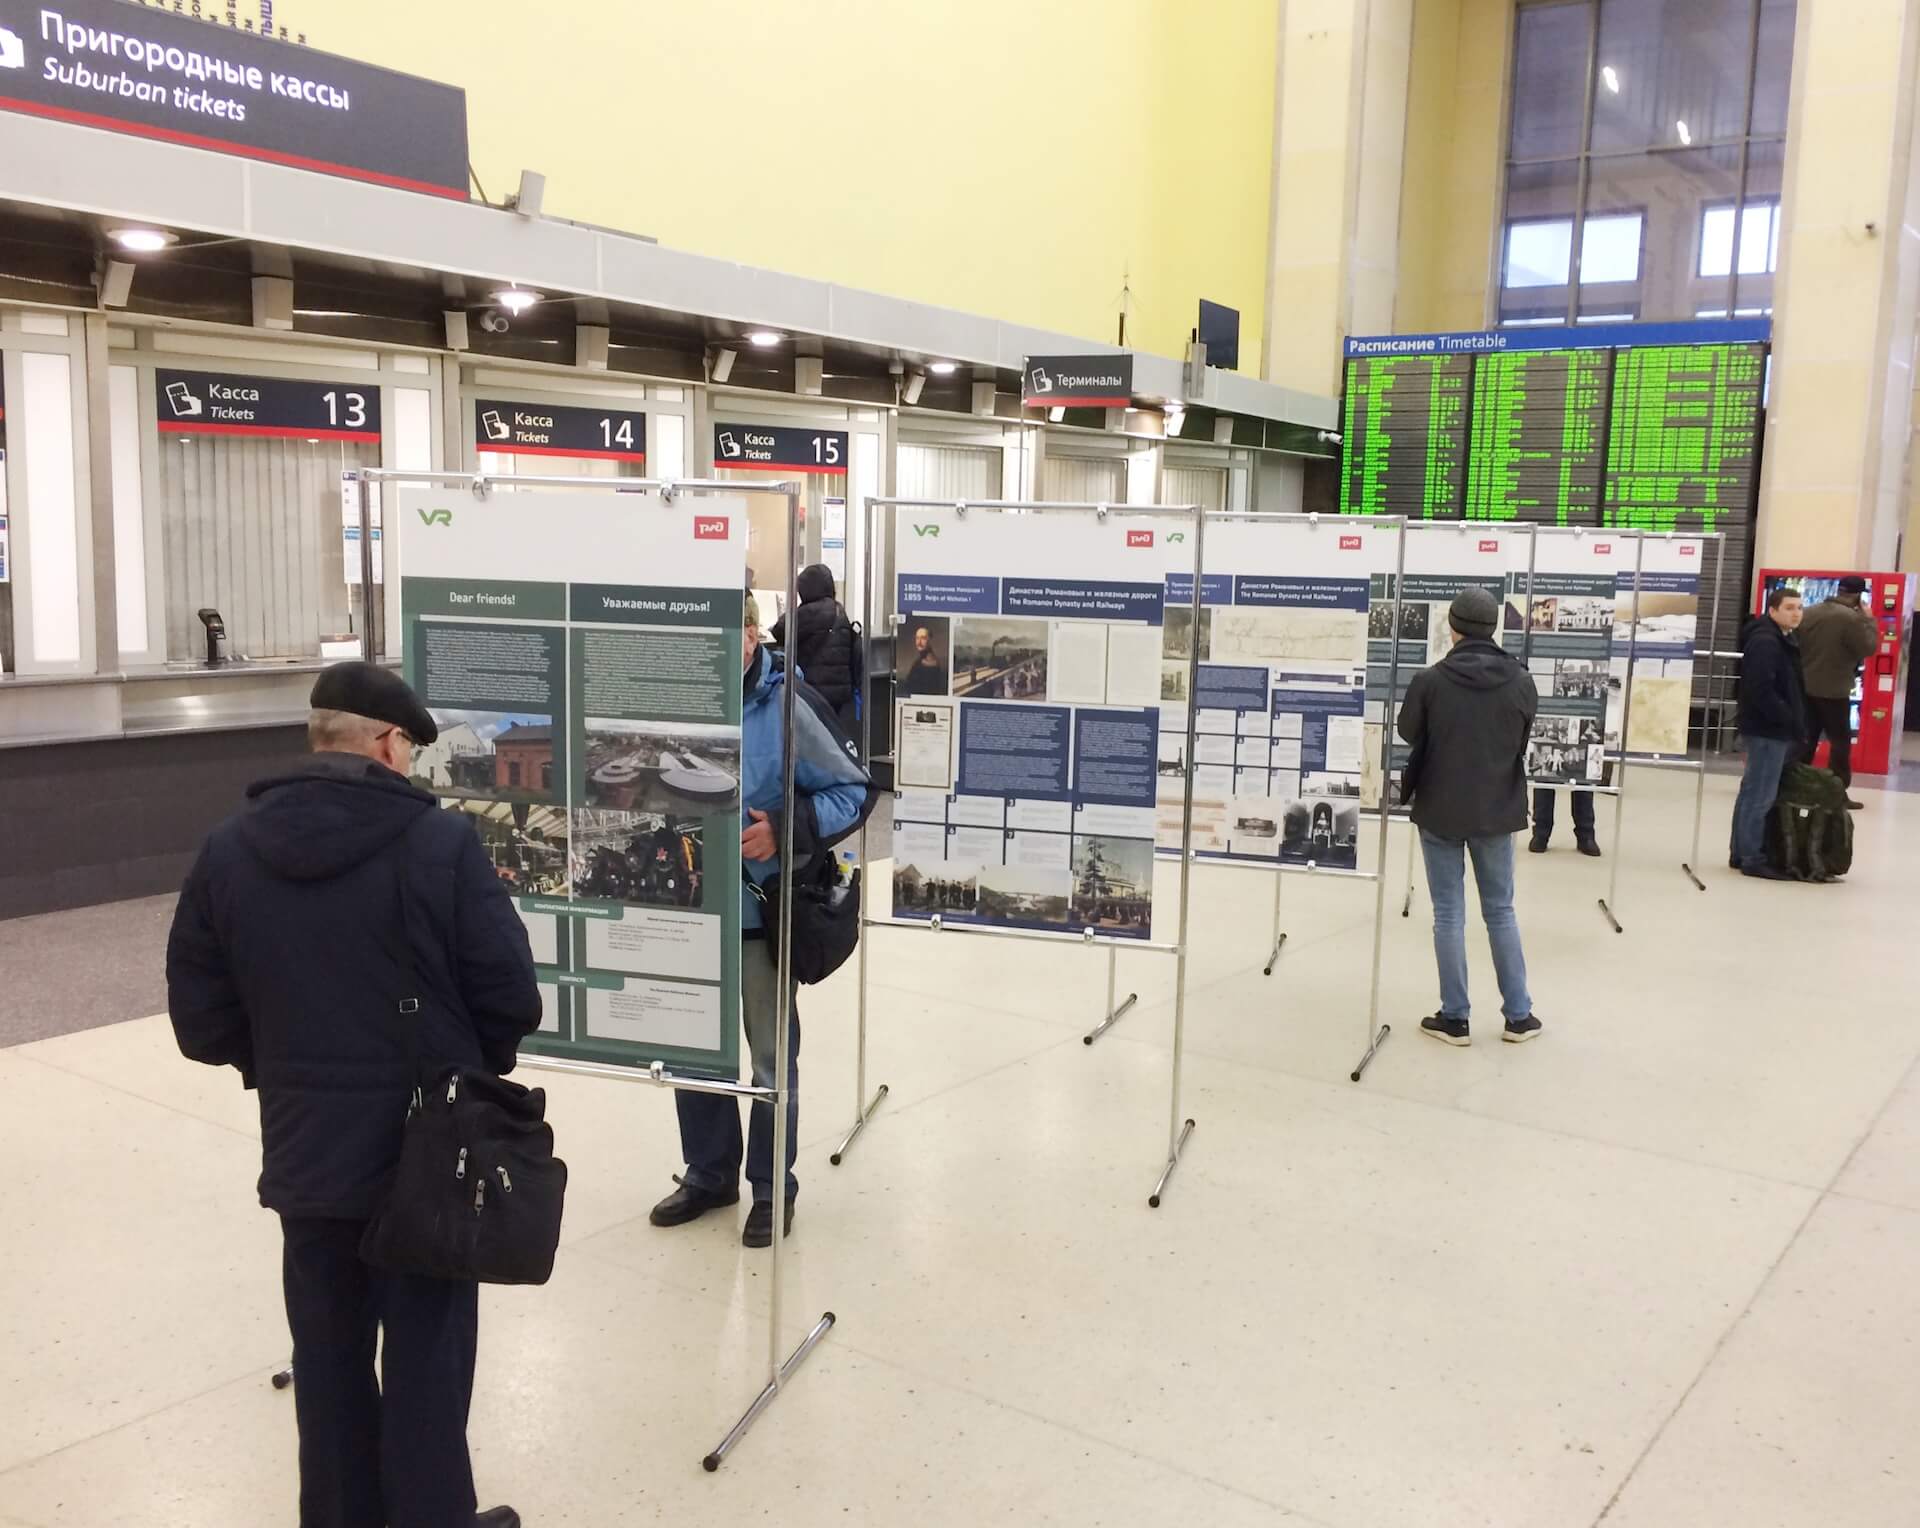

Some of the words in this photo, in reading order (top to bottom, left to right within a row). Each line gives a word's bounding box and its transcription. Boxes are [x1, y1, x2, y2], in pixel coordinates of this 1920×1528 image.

[40, 9, 263, 90] Пригородные
[270, 70, 349, 111] кассы
[43, 57, 166, 104] Suburban
[173, 87, 246, 121] tickets
[1349, 339, 1435, 352] Расписание
[1438, 334, 1506, 349] Timetable
[1056, 374, 1122, 389] Терминалы
[209, 383, 259, 401] Касса
[210, 406, 255, 420] Tickets
[323, 391, 365, 427] 13
[514, 412, 553, 428] Касса
[515, 431, 549, 443] Tickets
[599, 419, 634, 449] 14
[744, 433, 775, 446] Касса
[745, 449, 772, 460] Tickets
[812, 437, 839, 463] 15
[417, 508, 452, 527] VR
[913, 524, 940, 537] VR
[449, 591, 474, 604] Dear
[476, 592, 516, 606] friends!
[602, 597, 666, 611] Уважаемые
[669, 599, 711, 613] друзья!
[1009, 597, 1021, 606] The
[1054, 599, 1081, 610] Dynasty
[1082, 600, 1094, 609] and
[1131, 592, 1157, 602] дороги
